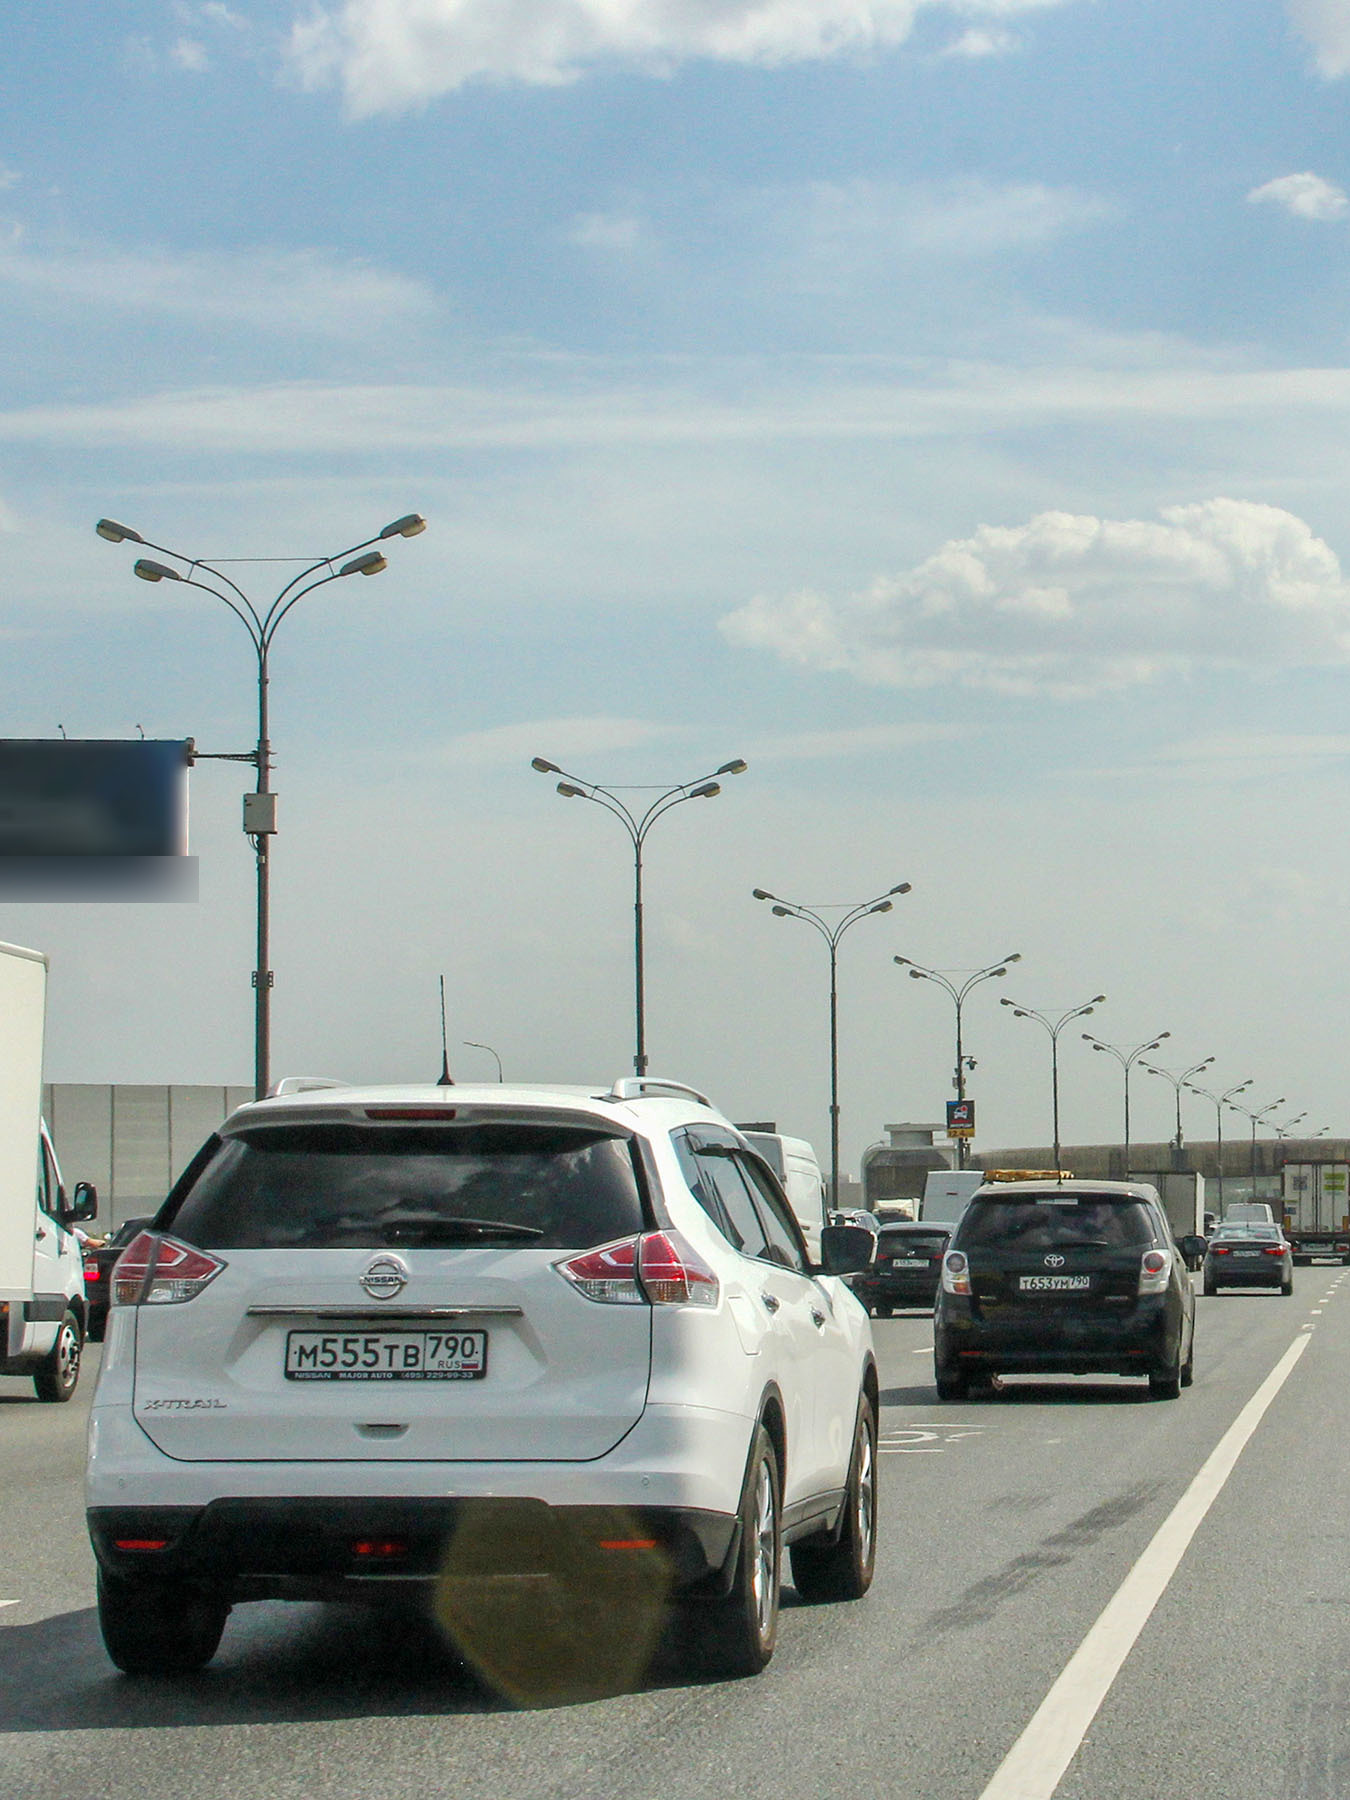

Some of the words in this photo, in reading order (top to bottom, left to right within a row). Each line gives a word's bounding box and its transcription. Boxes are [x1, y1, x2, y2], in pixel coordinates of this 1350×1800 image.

[428, 1336, 476, 1359] 790
[437, 1360, 461, 1369] RUS
[144, 1399, 228, 1410] X-TRAIL
